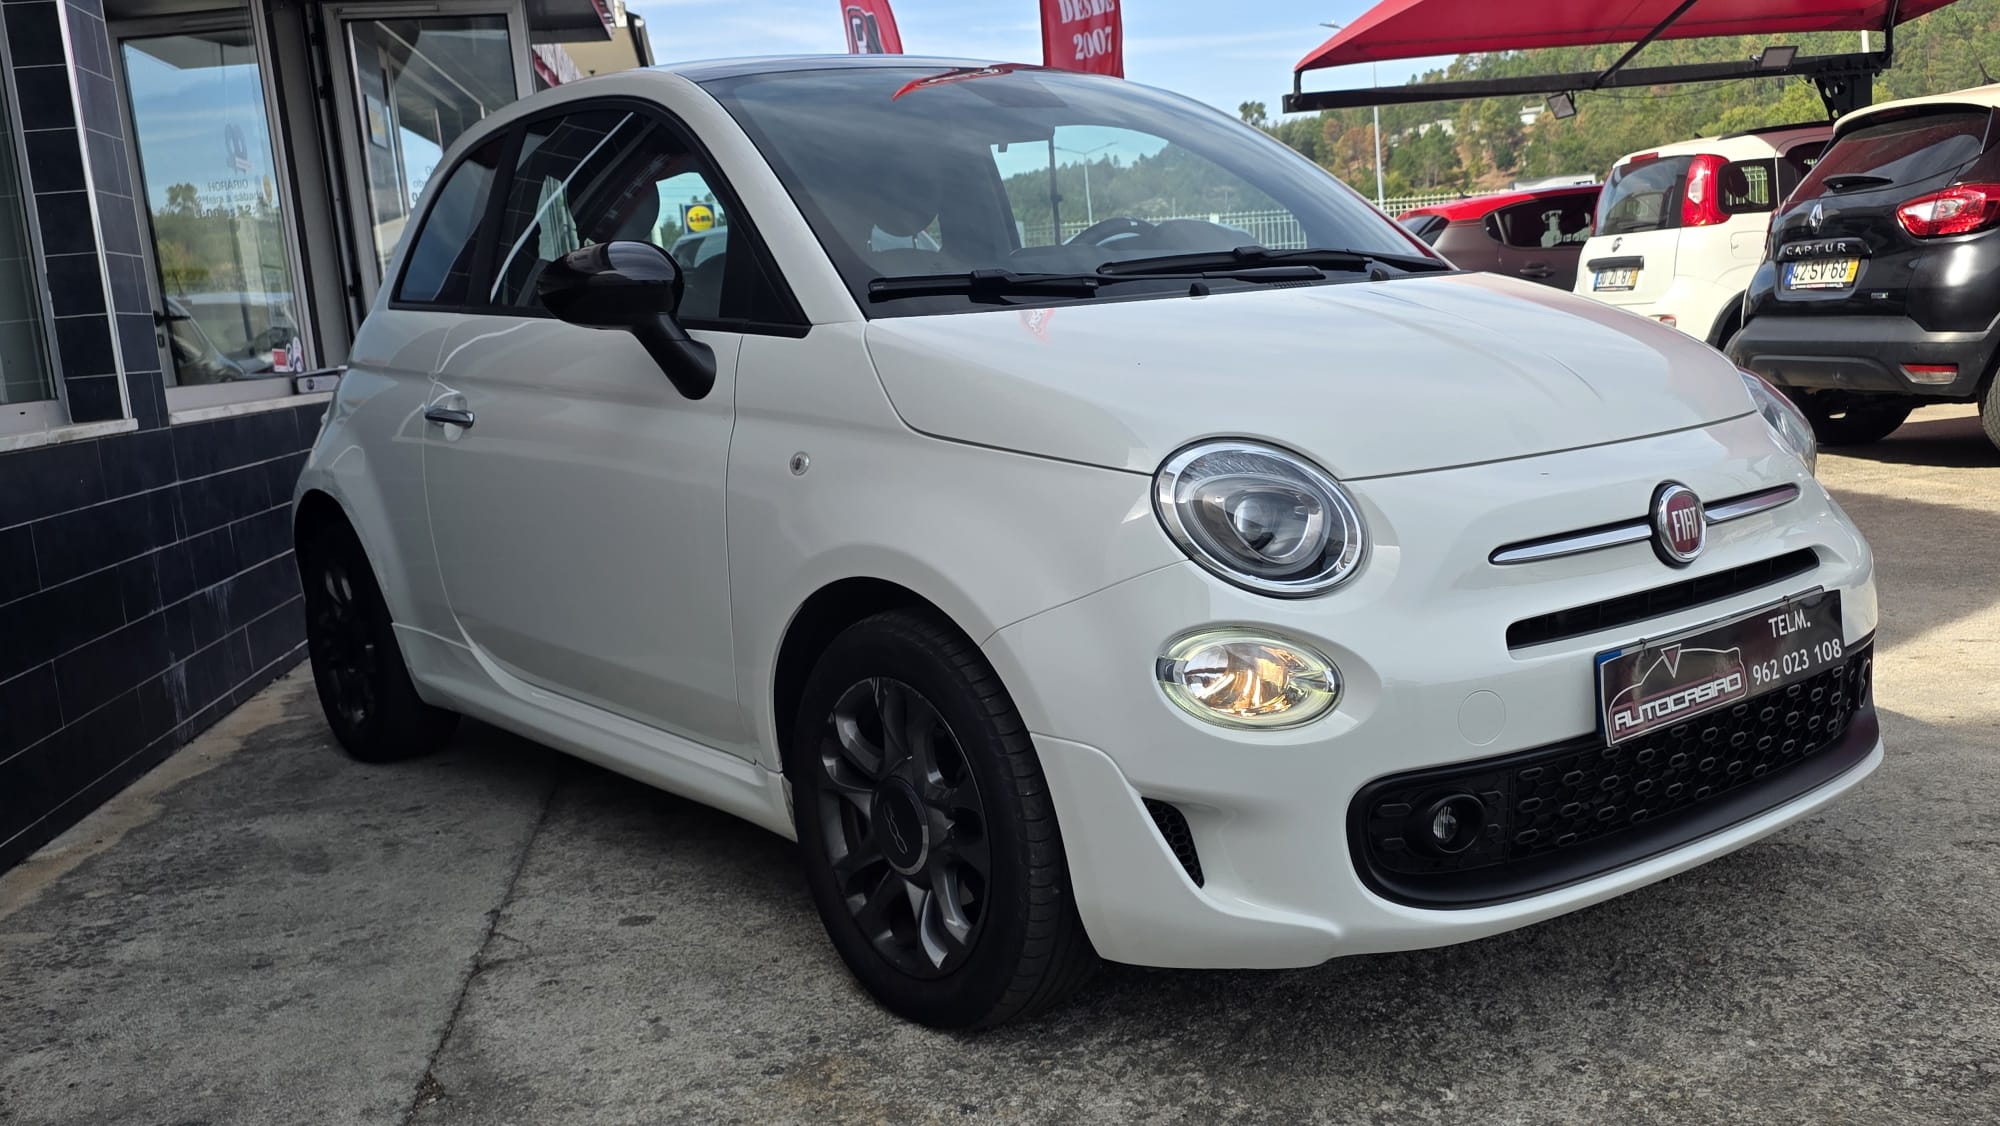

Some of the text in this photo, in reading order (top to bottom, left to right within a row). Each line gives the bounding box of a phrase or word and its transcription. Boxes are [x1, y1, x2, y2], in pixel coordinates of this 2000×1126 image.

[1072, 26, 1112, 61] 2007
[1786, 242, 1847, 256] CAPTUR
[1671, 506, 1698, 543] FIAT
[1768, 609, 1812, 638] TELM.
[1753, 637, 1843, 686] 962 023 108
